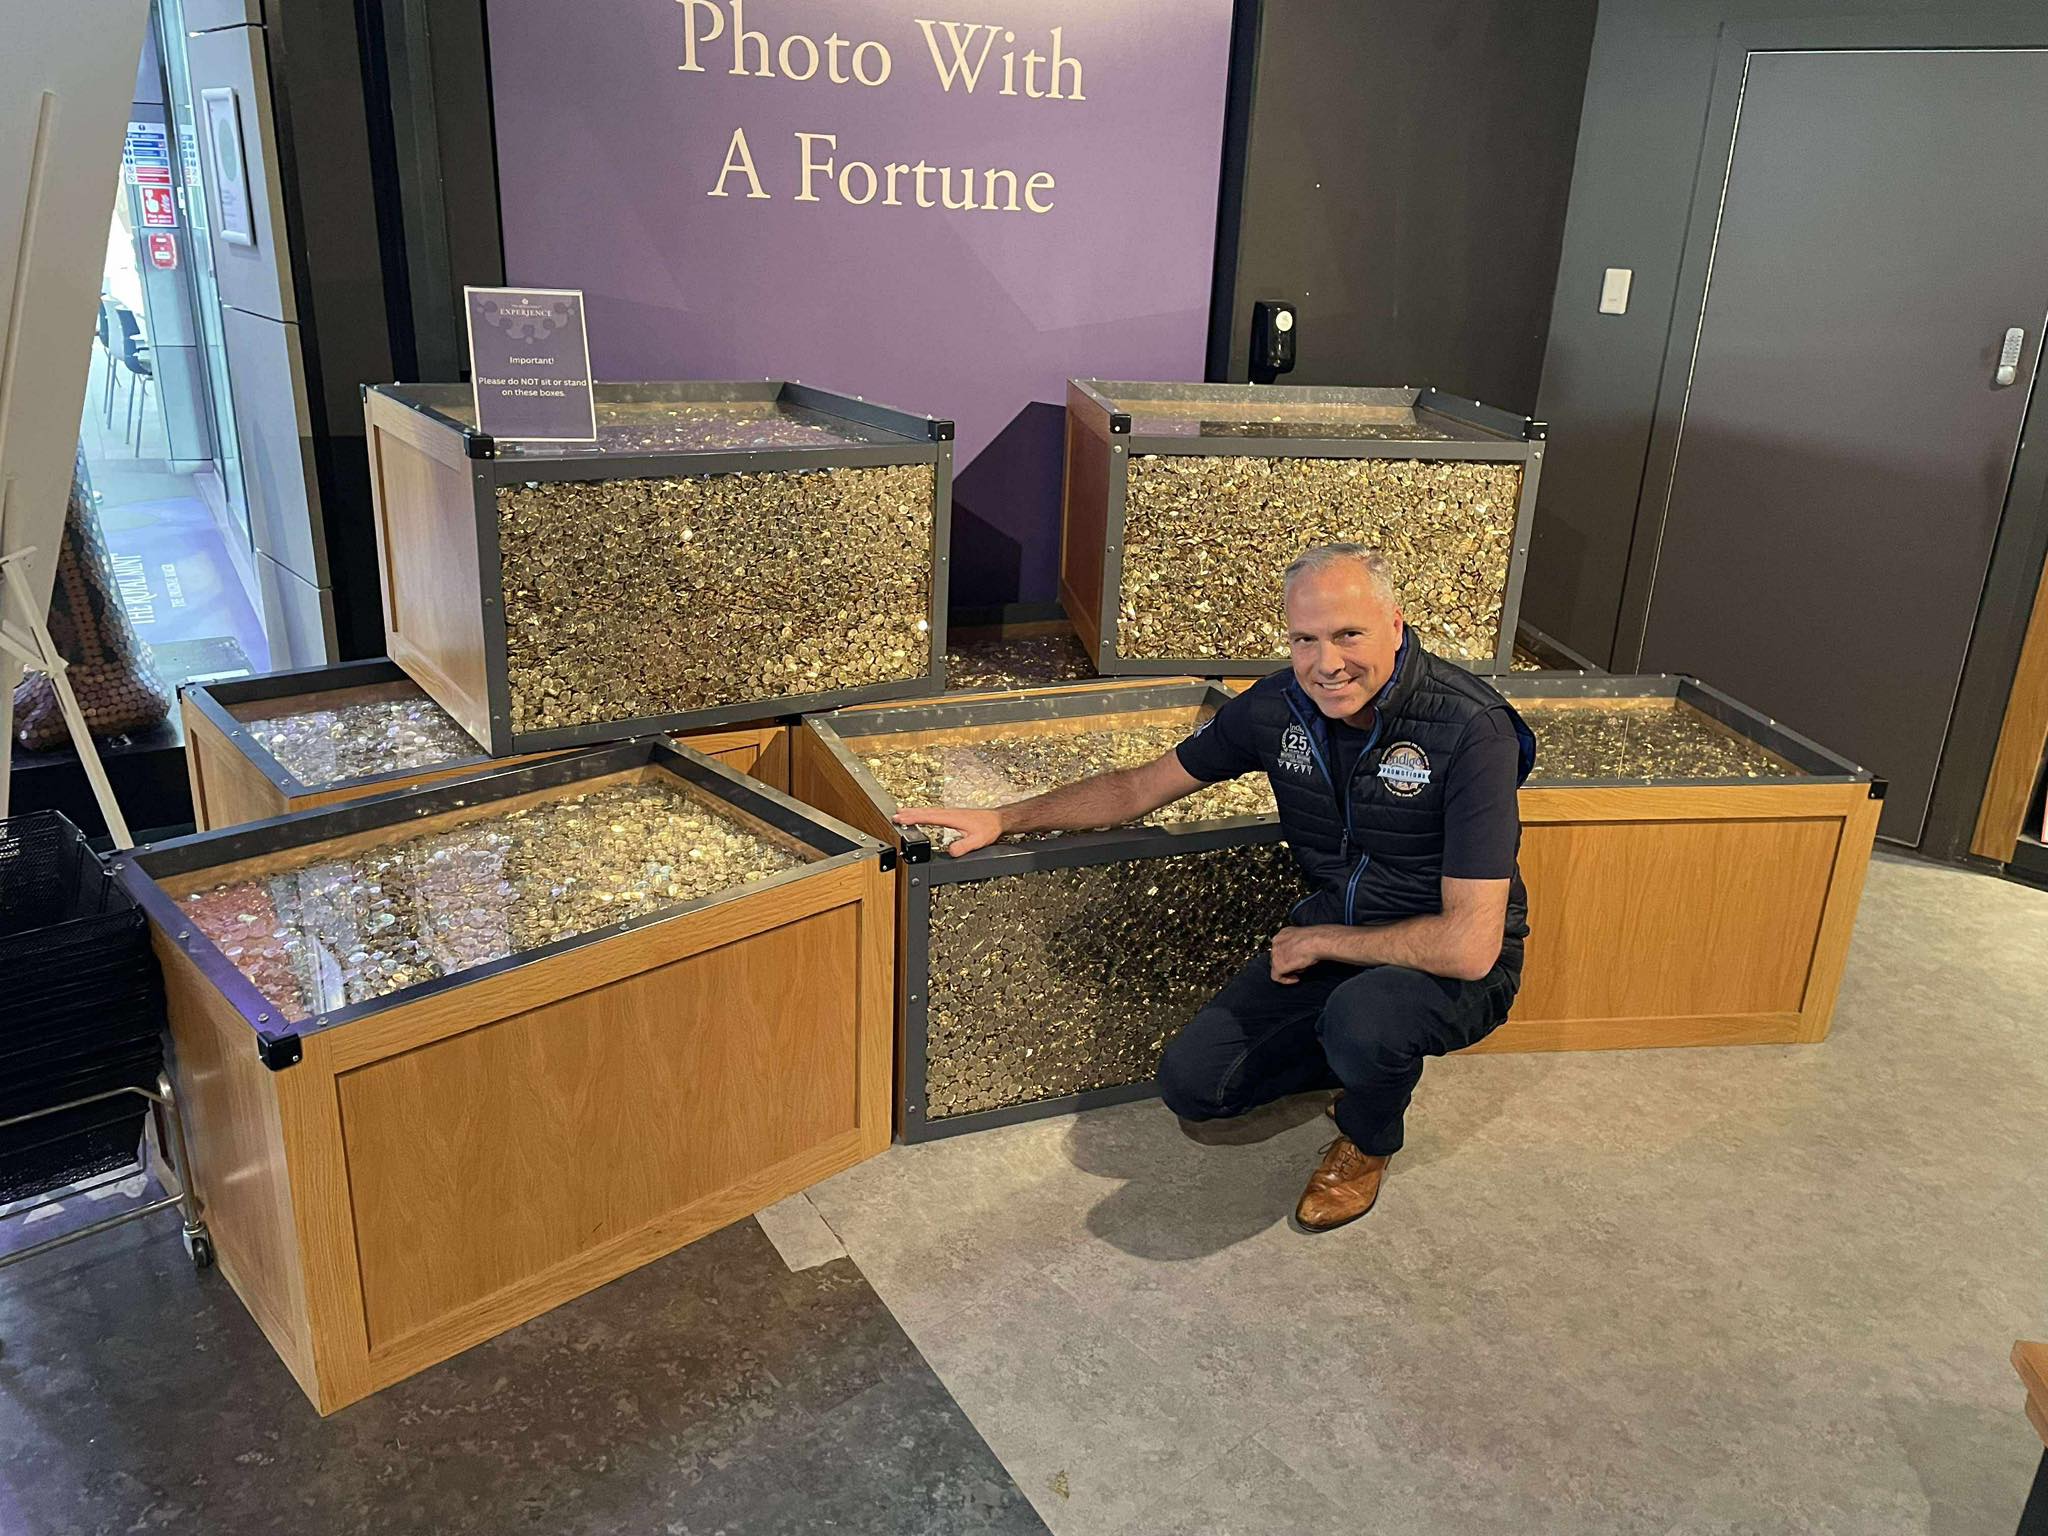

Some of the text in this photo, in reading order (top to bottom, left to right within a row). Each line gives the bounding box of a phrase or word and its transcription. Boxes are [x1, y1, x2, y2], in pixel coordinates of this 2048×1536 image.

[676, 0, 1087, 101] Photo With
[706, 127, 1056, 214] A Fortune
[500, 308, 552, 317] EXPERIENCE
[509, 356, 554, 365] Important!
[478, 377, 506, 386] Please
[507, 378, 519, 386] do
[520, 378, 539, 386] NOT
[541, 379, 552, 387] sit
[563, 379, 587, 388] stand
[501, 389, 513, 397] on
[514, 389, 538, 398] these
[1288, 733, 1308, 751] 25
